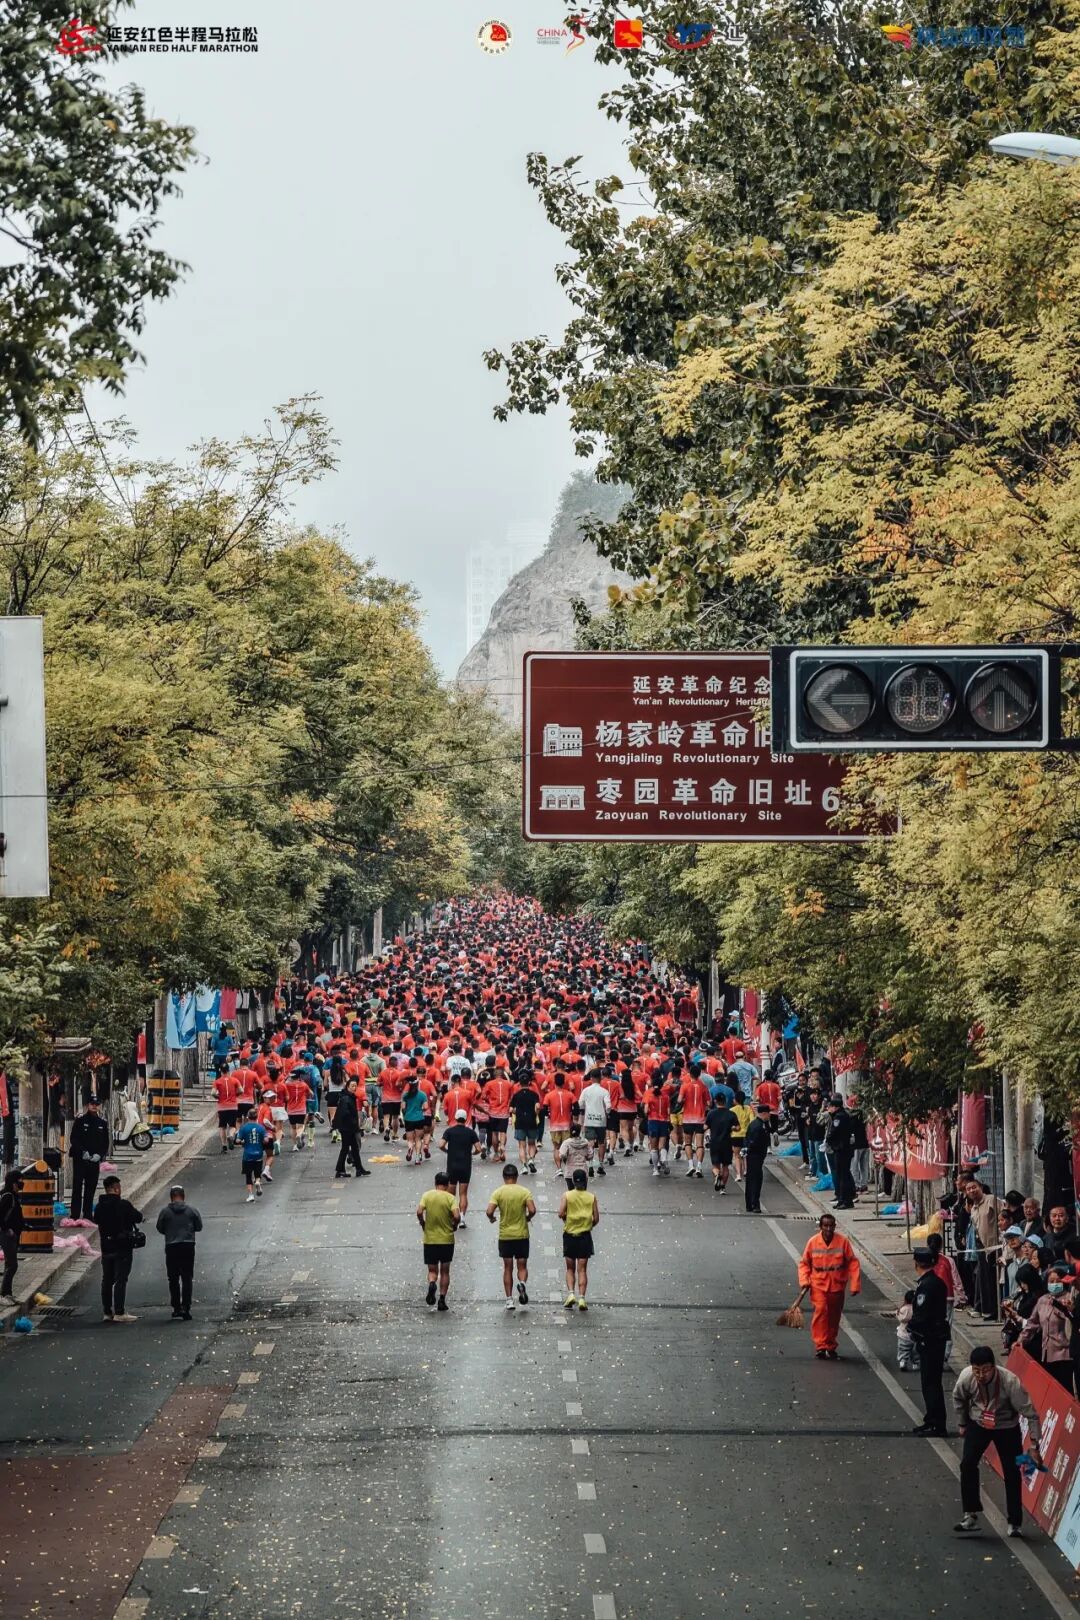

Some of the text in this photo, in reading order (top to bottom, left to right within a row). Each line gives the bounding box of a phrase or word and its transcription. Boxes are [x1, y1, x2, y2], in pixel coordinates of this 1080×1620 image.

[632, 675, 771, 695] 延安革命纪念
[633, 697, 662, 706] Yan'an
[669, 697, 730, 708] Revolutionary
[596, 753, 795, 766] Yangjialing Revolutionary Site
[596, 777, 813, 806] 枣园革命旧址
[596, 810, 782, 822] Zaoyuan Revolutionary Site
